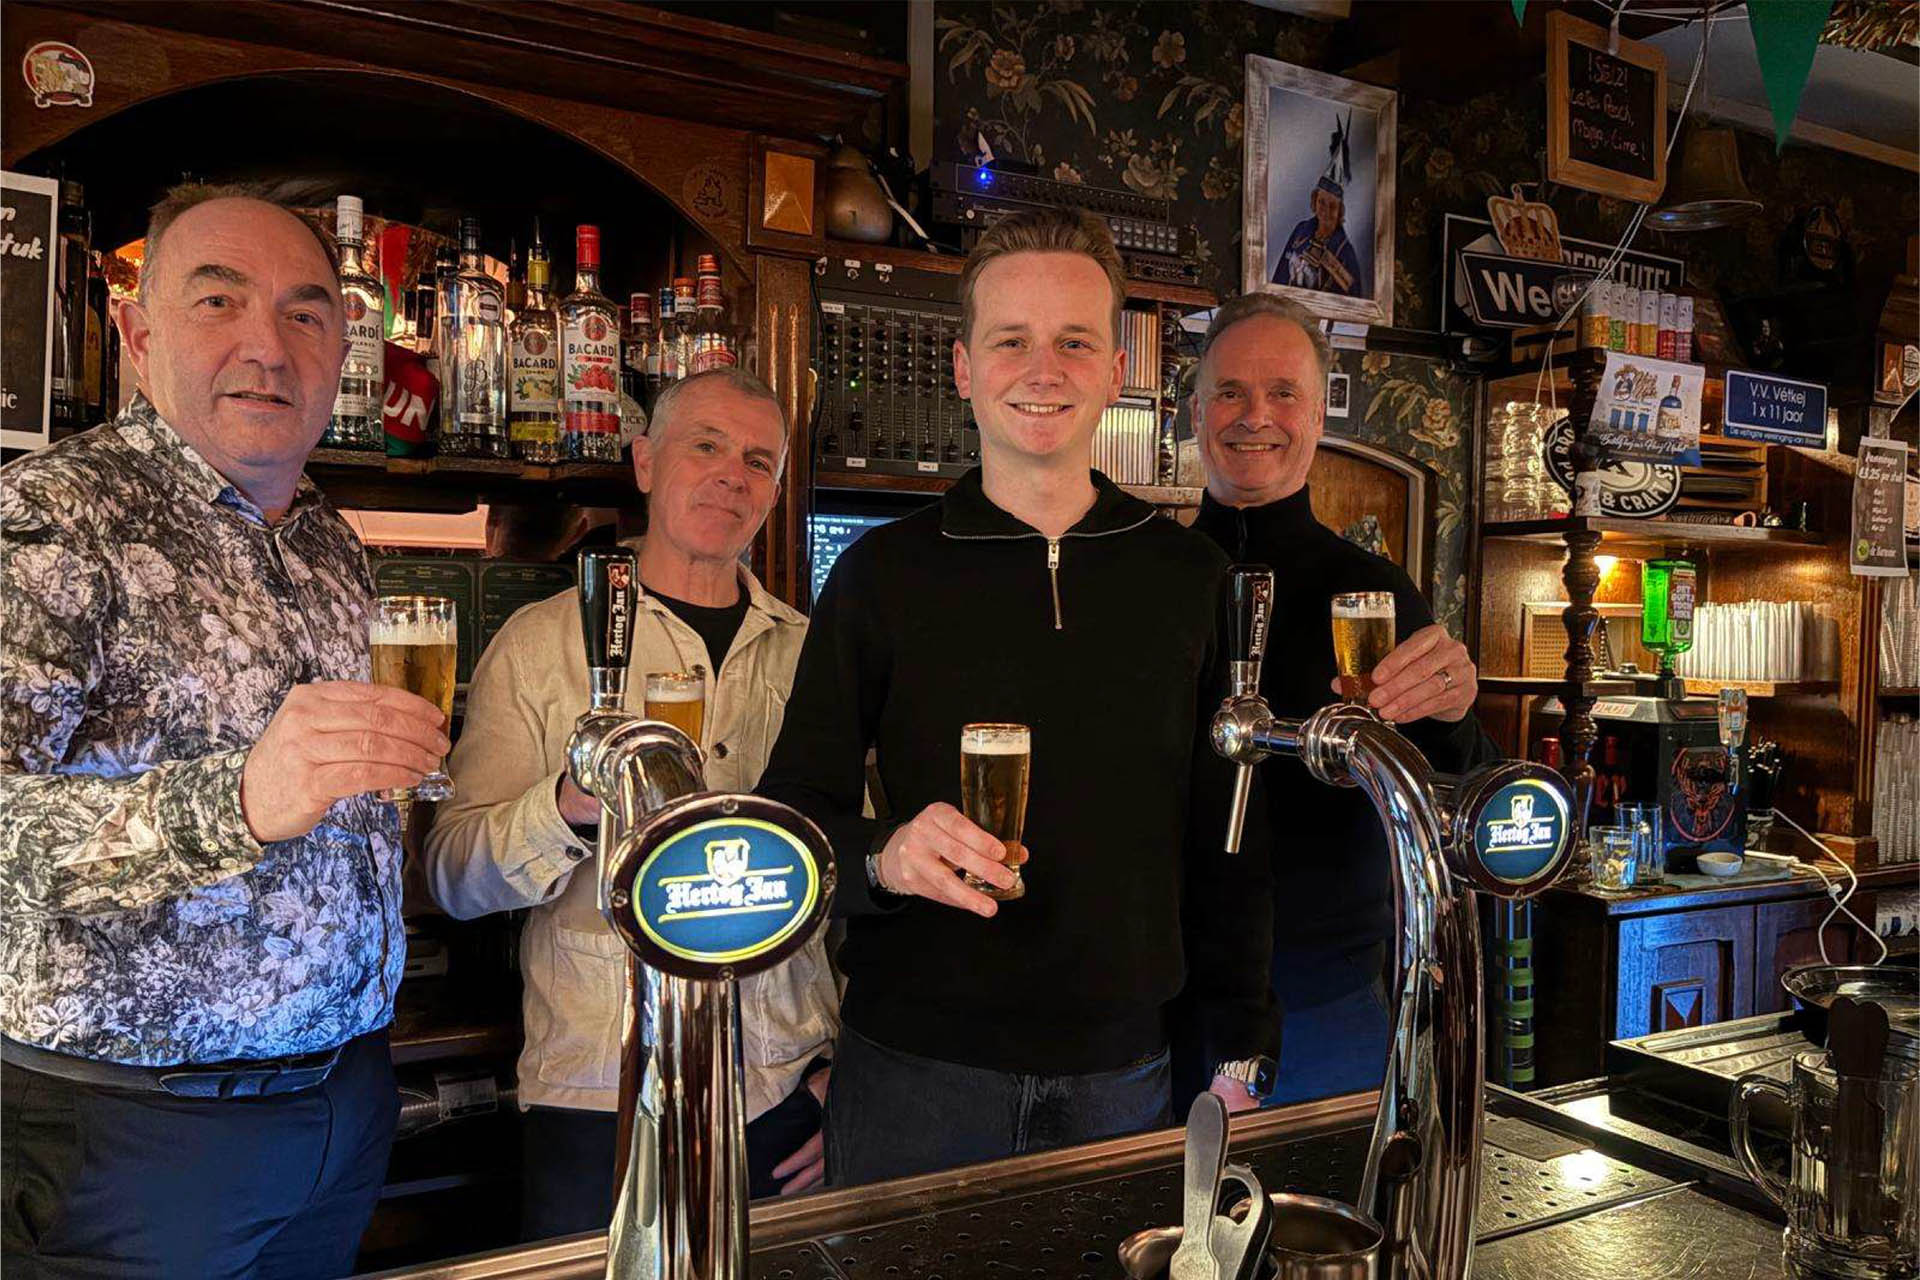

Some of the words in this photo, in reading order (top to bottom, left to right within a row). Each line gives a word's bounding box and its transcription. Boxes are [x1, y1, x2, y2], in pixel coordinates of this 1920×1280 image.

[1481, 269, 1552, 319] We
[513, 358, 556, 369] BACARD
[1770, 404, 1780, 420] 11
[1620, 481, 1671, 511] CRAFT
[612, 590, 626, 614] Jan
[1254, 603, 1265, 622] Jan
[609, 615, 626, 657] Hertog
[1250, 622, 1264, 656] Hertog
[1489, 824, 1530, 848] Hertog
[1529, 824, 1552, 844] Jan
[665, 881, 745, 914] Hertog
[744, 876, 788, 905] Jan
